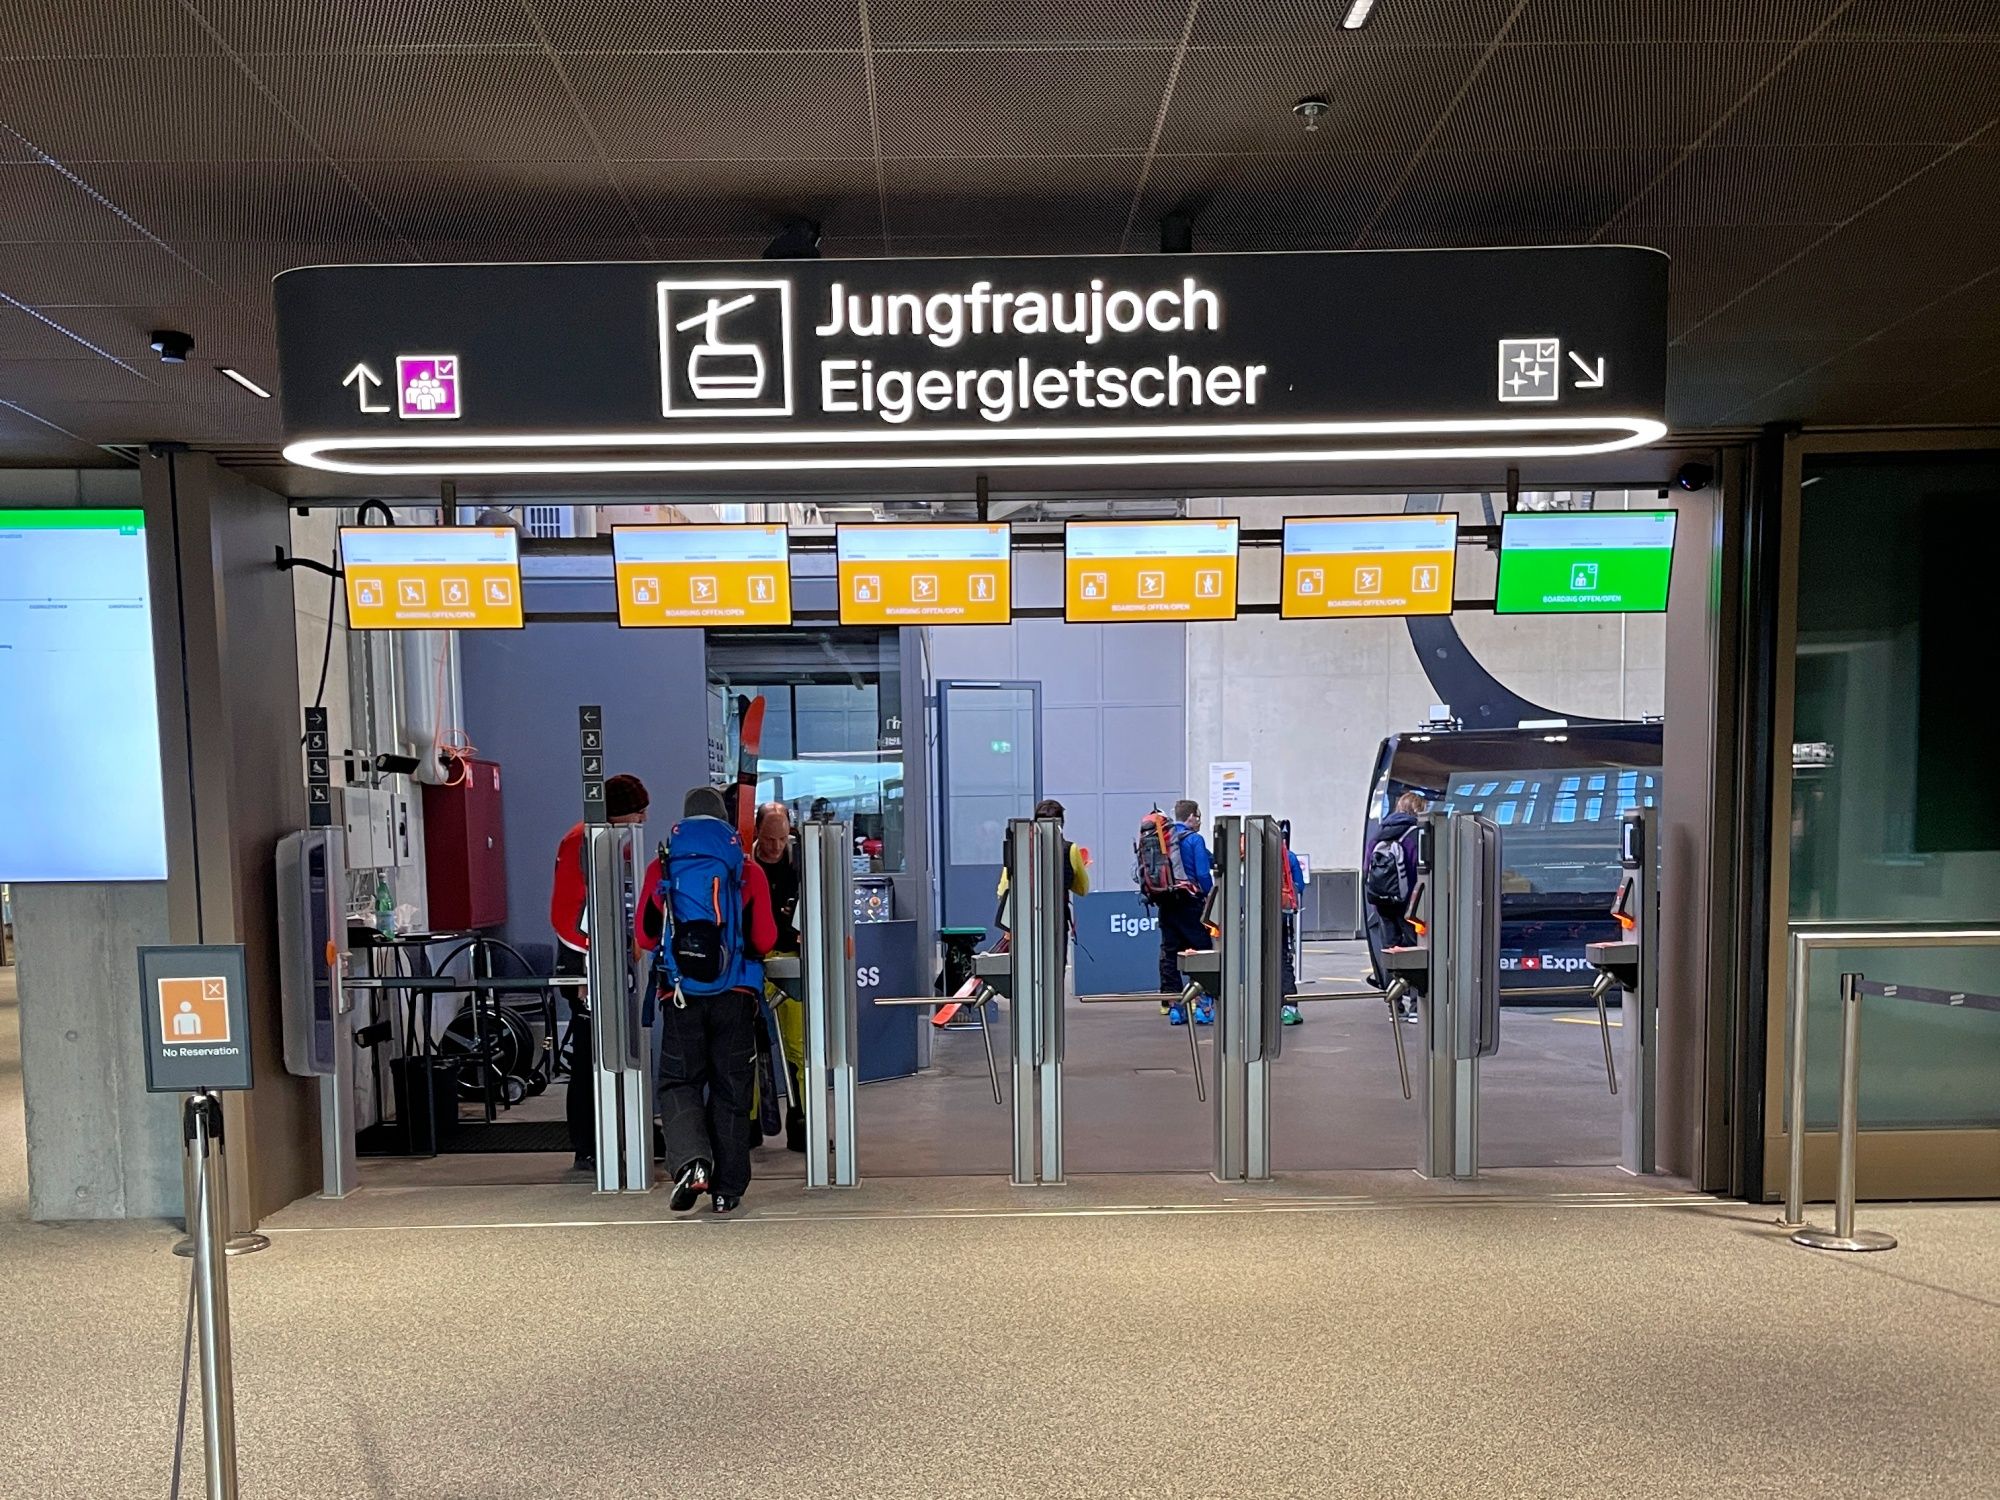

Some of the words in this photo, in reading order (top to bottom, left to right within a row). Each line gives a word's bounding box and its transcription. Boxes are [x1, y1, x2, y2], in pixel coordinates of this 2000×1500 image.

[815, 278, 1219, 347] Jungfraujoch
[820, 355, 1267, 423] Eigergletscher
[1110, 913, 1159, 936] Eiger
[163, 1048, 178, 1057] No
[180, 1047, 239, 1056] Reservation
